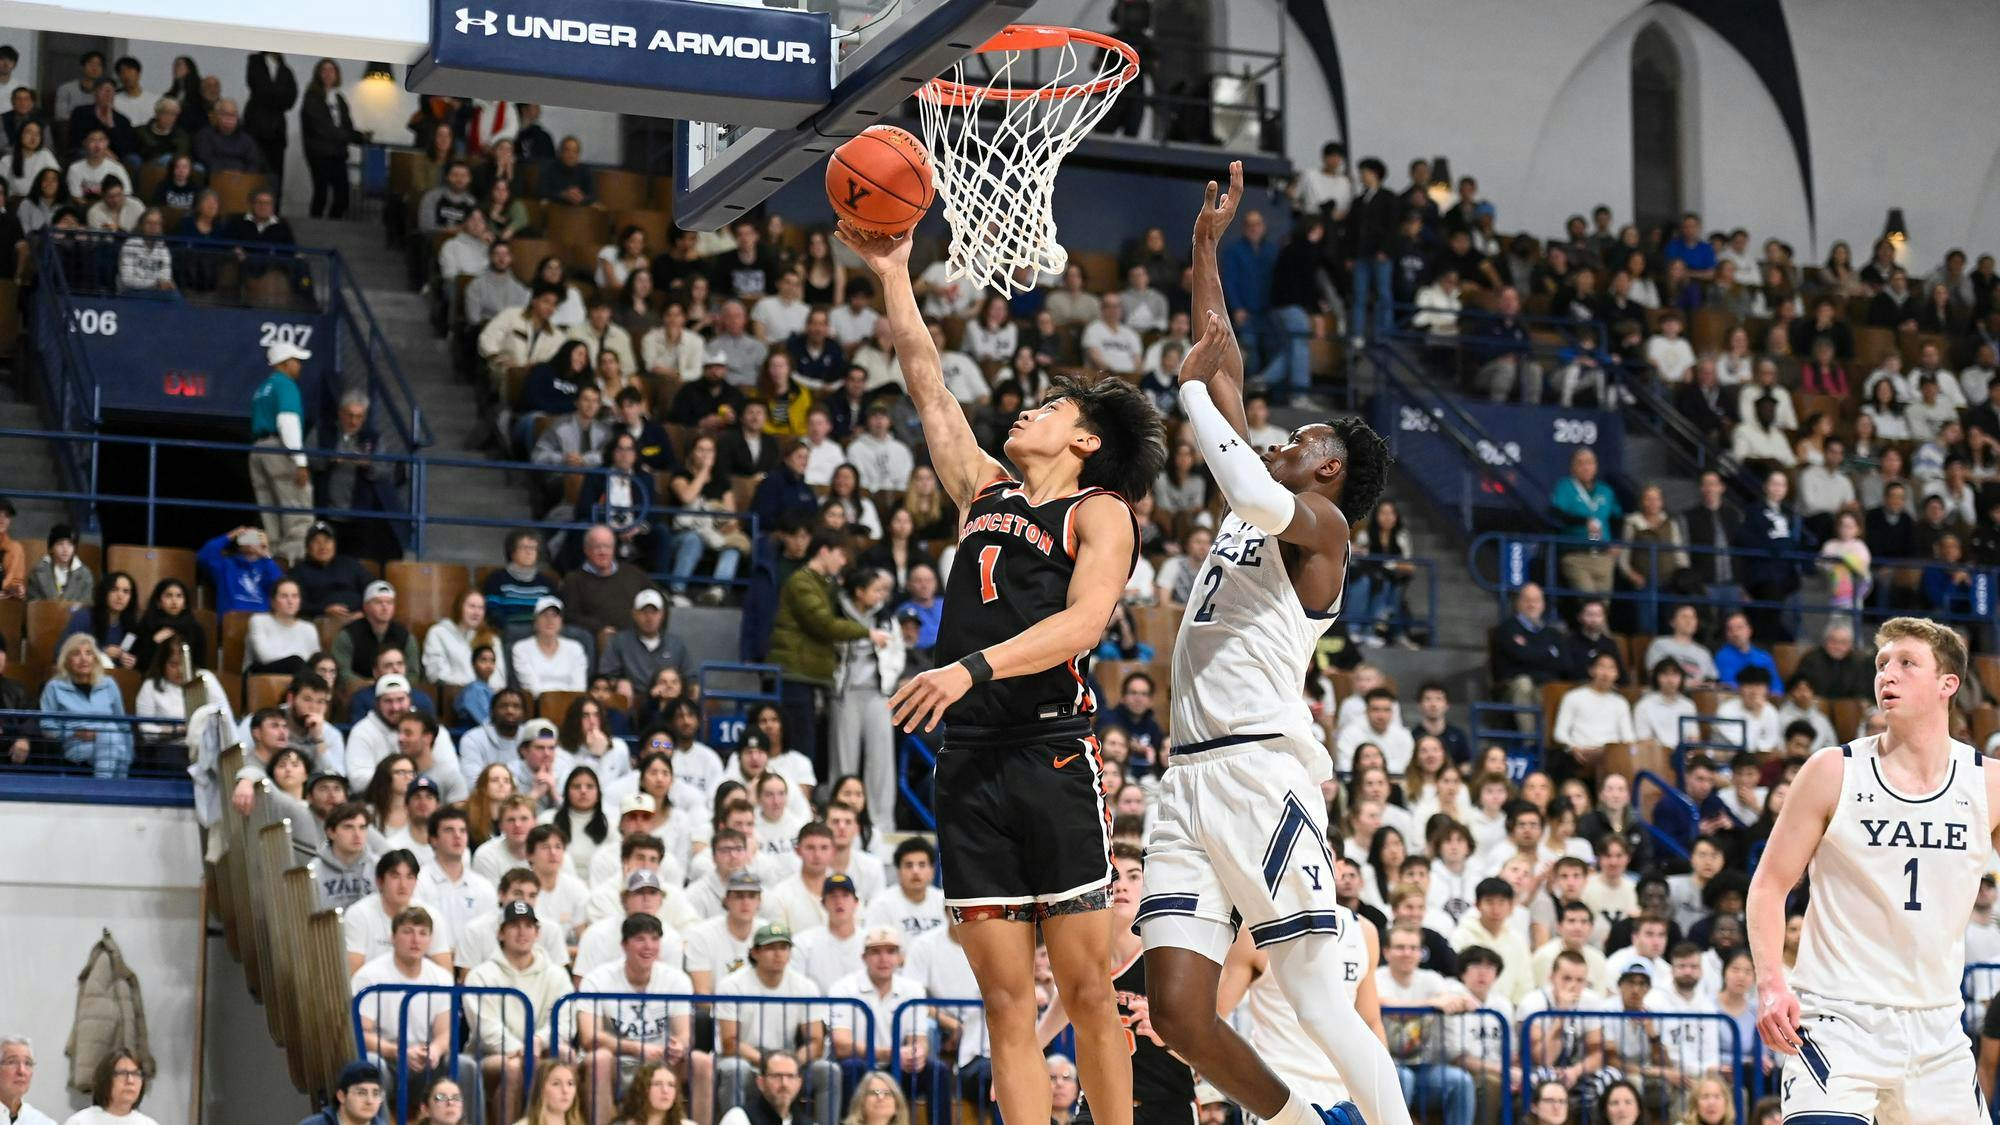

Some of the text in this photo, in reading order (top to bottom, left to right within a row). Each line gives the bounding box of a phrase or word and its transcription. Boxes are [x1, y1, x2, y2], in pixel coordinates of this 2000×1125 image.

[506, 14, 637, 48] UNDER
[844, 177, 871, 209] Y
[64, 308, 117, 335] 06
[259, 322, 313, 347] 207
[1553, 418, 1598, 445] 209
[978, 545, 1003, 605] 1
[1193, 565, 1223, 622] 2
[1860, 819, 1968, 851] YALE
[1303, 865, 1322, 890] Y
[1903, 857, 1922, 911] 1
[1783, 1076, 1797, 1102] Y
